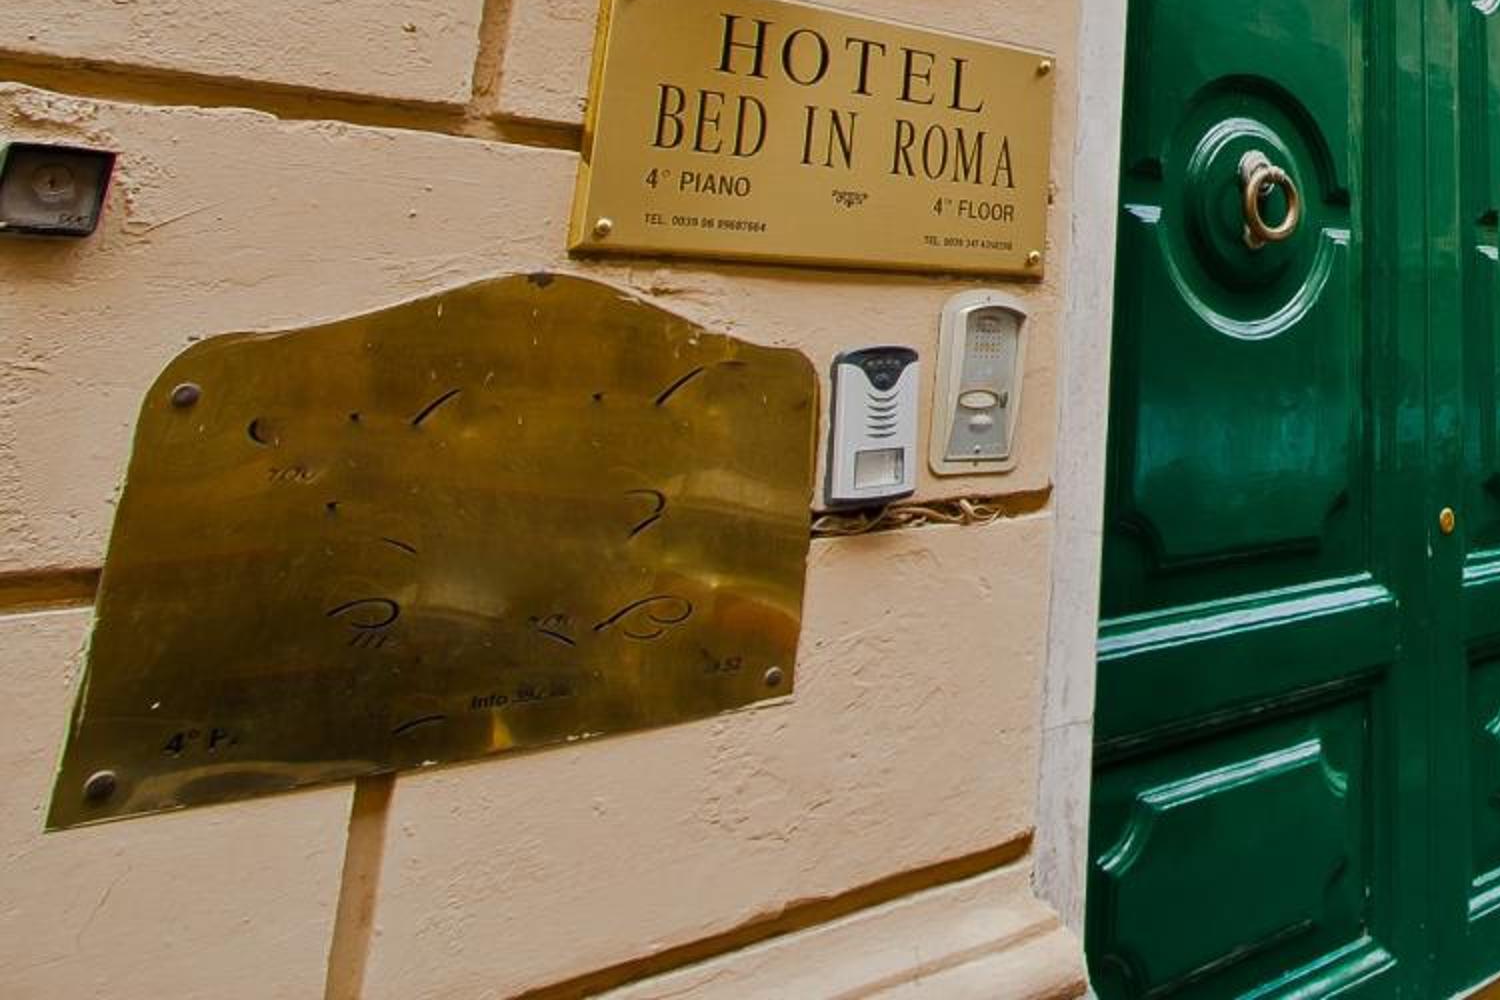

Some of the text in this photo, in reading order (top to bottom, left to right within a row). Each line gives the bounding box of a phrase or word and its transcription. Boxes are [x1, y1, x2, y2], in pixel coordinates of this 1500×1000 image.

[714, 12, 985, 111] HOTEL
[652, 84, 1016, 189] BED IN ROMA
[680, 171, 751, 197] PIANO
[958, 199, 1015, 222] FLOOR
